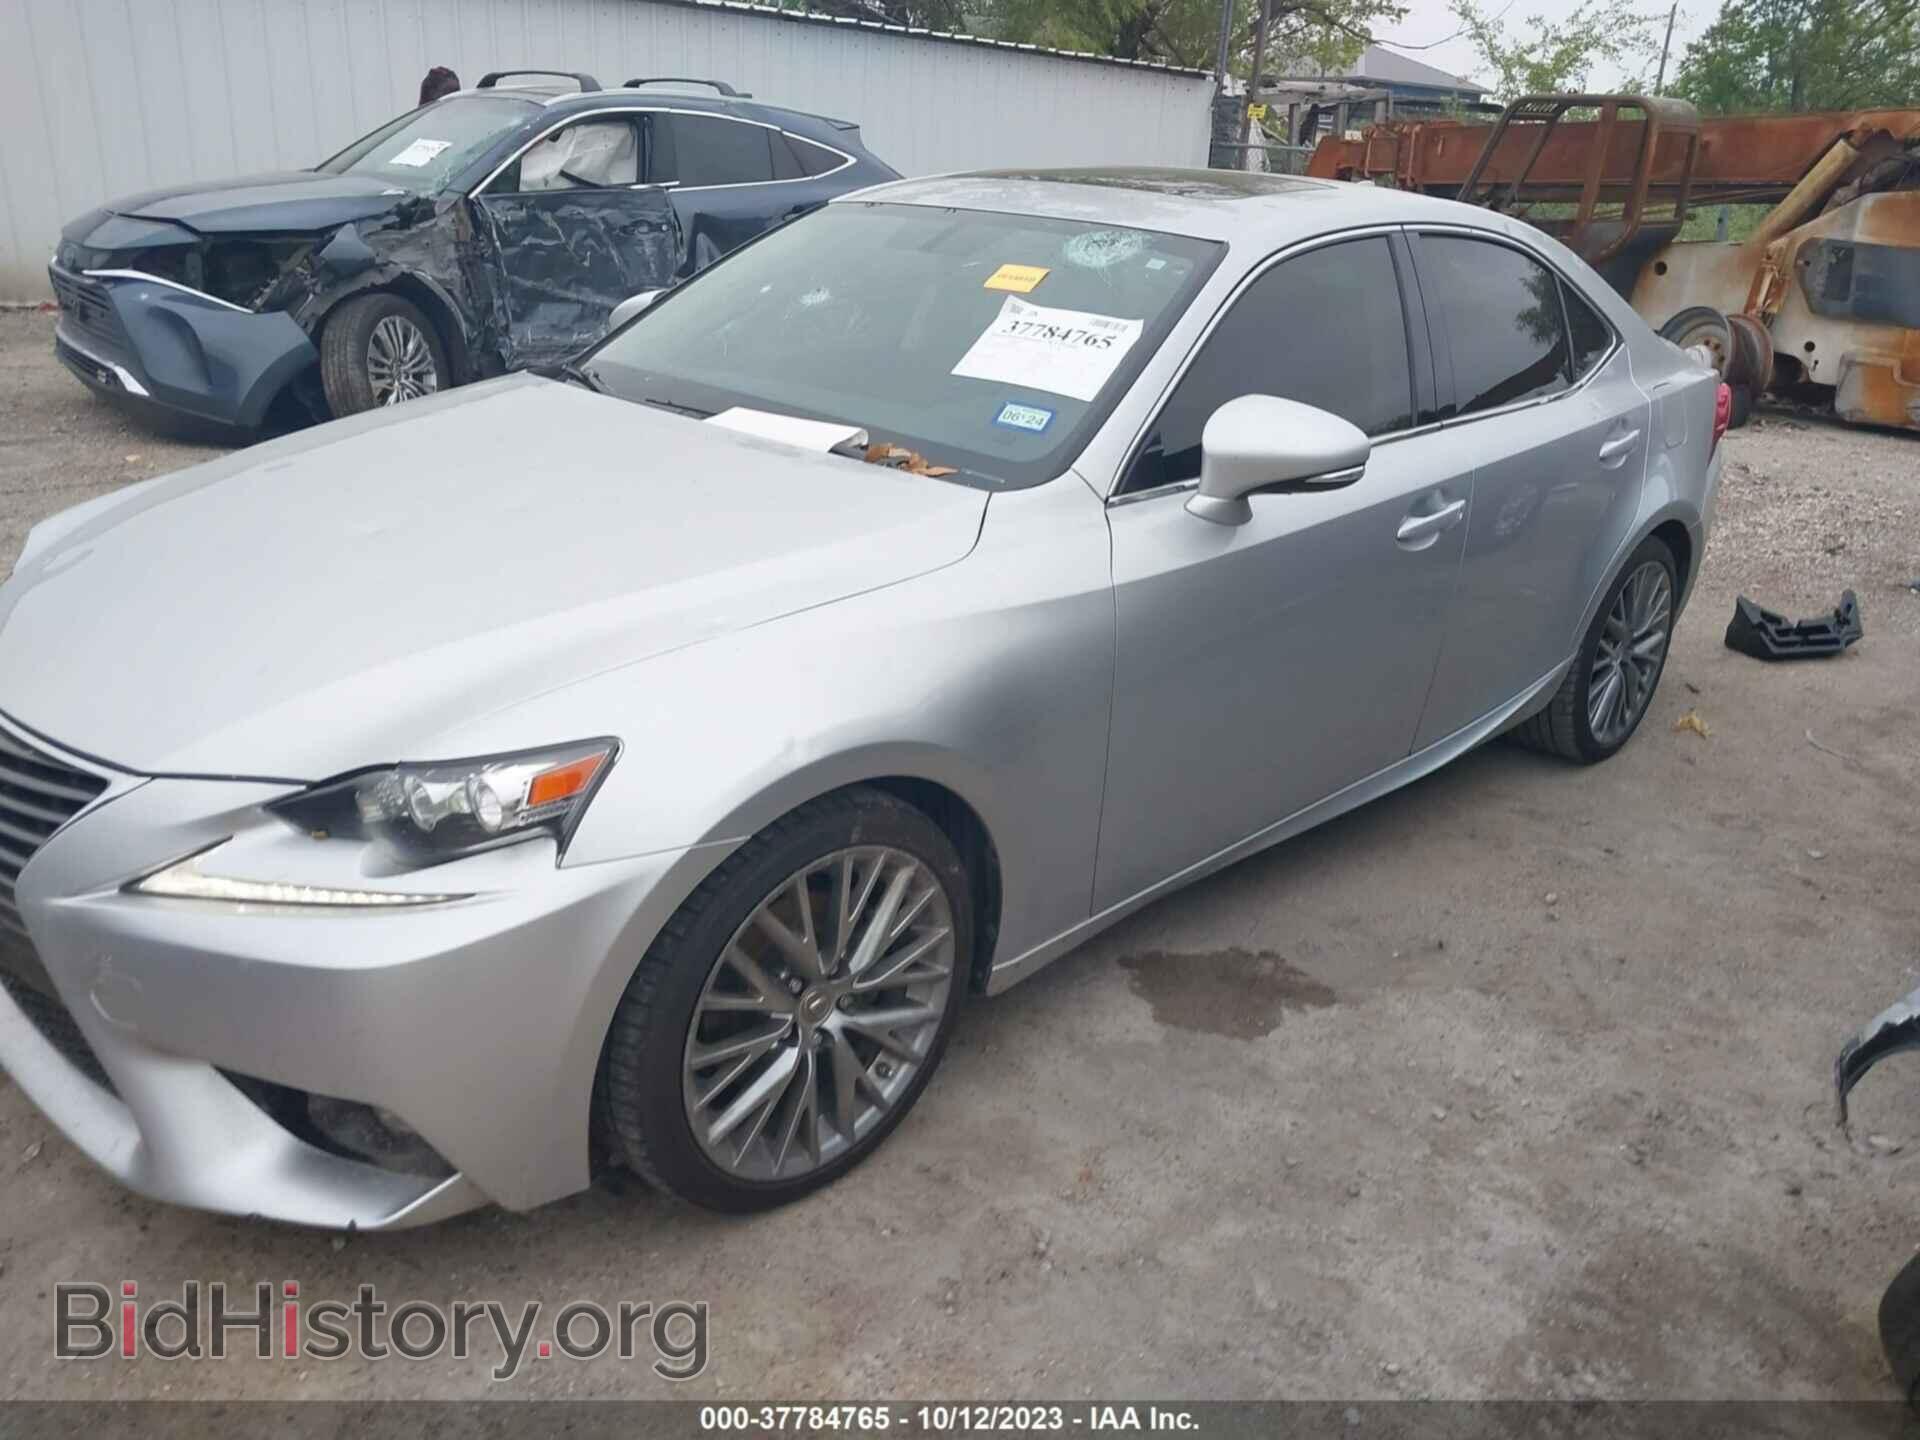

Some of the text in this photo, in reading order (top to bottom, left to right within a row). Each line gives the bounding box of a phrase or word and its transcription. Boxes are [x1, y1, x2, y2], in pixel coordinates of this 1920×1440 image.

[1002, 320, 1118, 350] 37784765
[1002, 410, 1046, 427] 06 24
